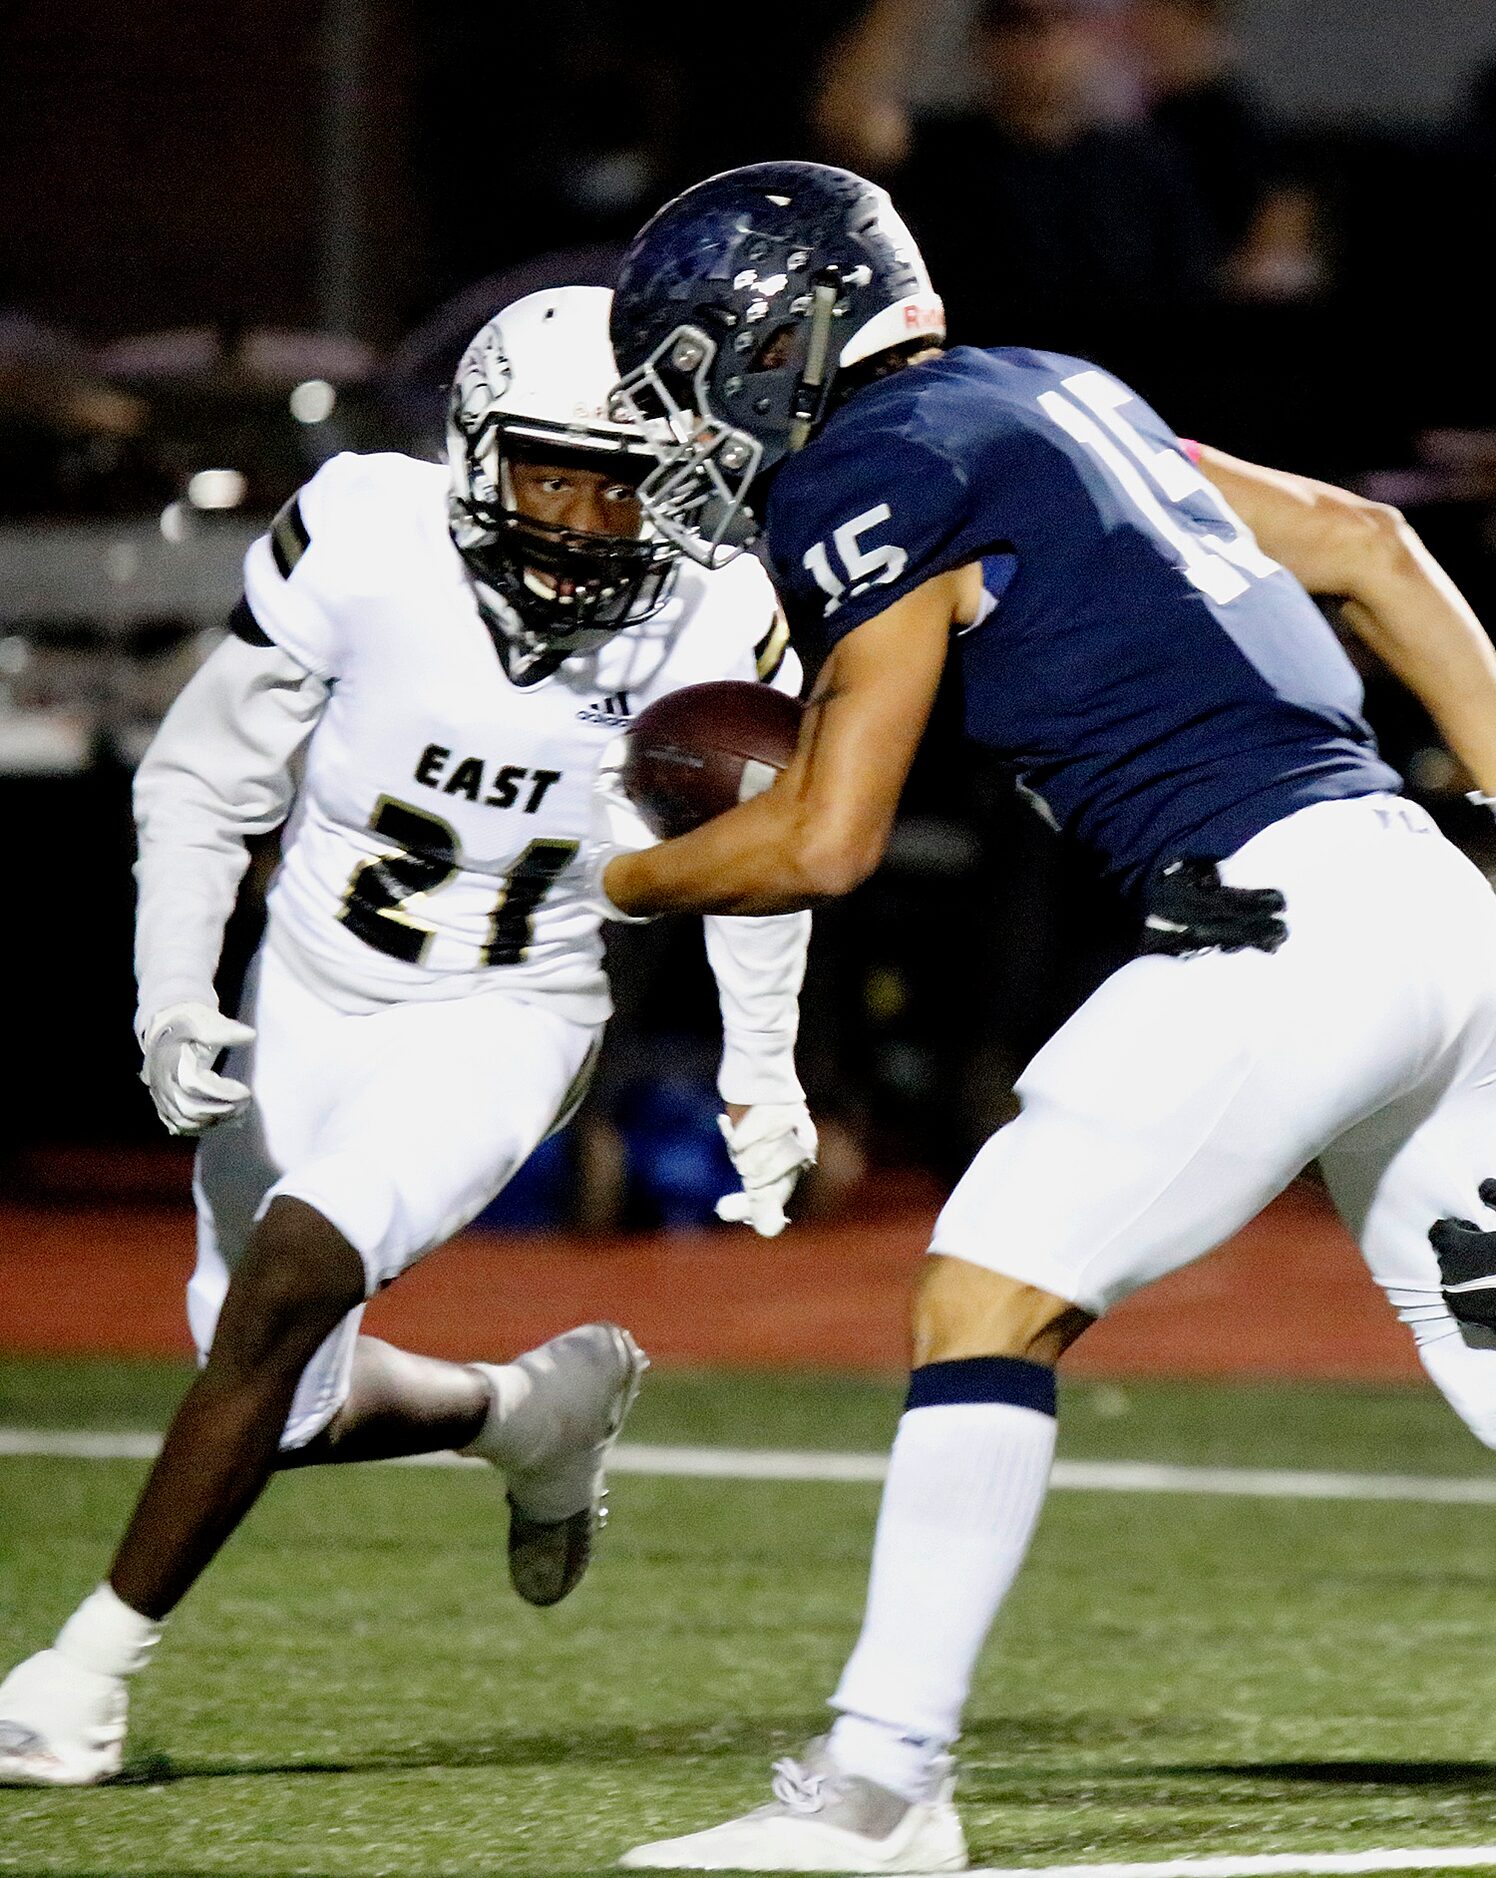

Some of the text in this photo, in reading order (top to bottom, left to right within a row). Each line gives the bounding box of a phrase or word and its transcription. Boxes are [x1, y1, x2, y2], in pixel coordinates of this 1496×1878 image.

[1037, 370, 1282, 605] 15
[803, 503, 908, 617] 15
[415, 743, 562, 814] EAST
[336, 793, 580, 967] 21
